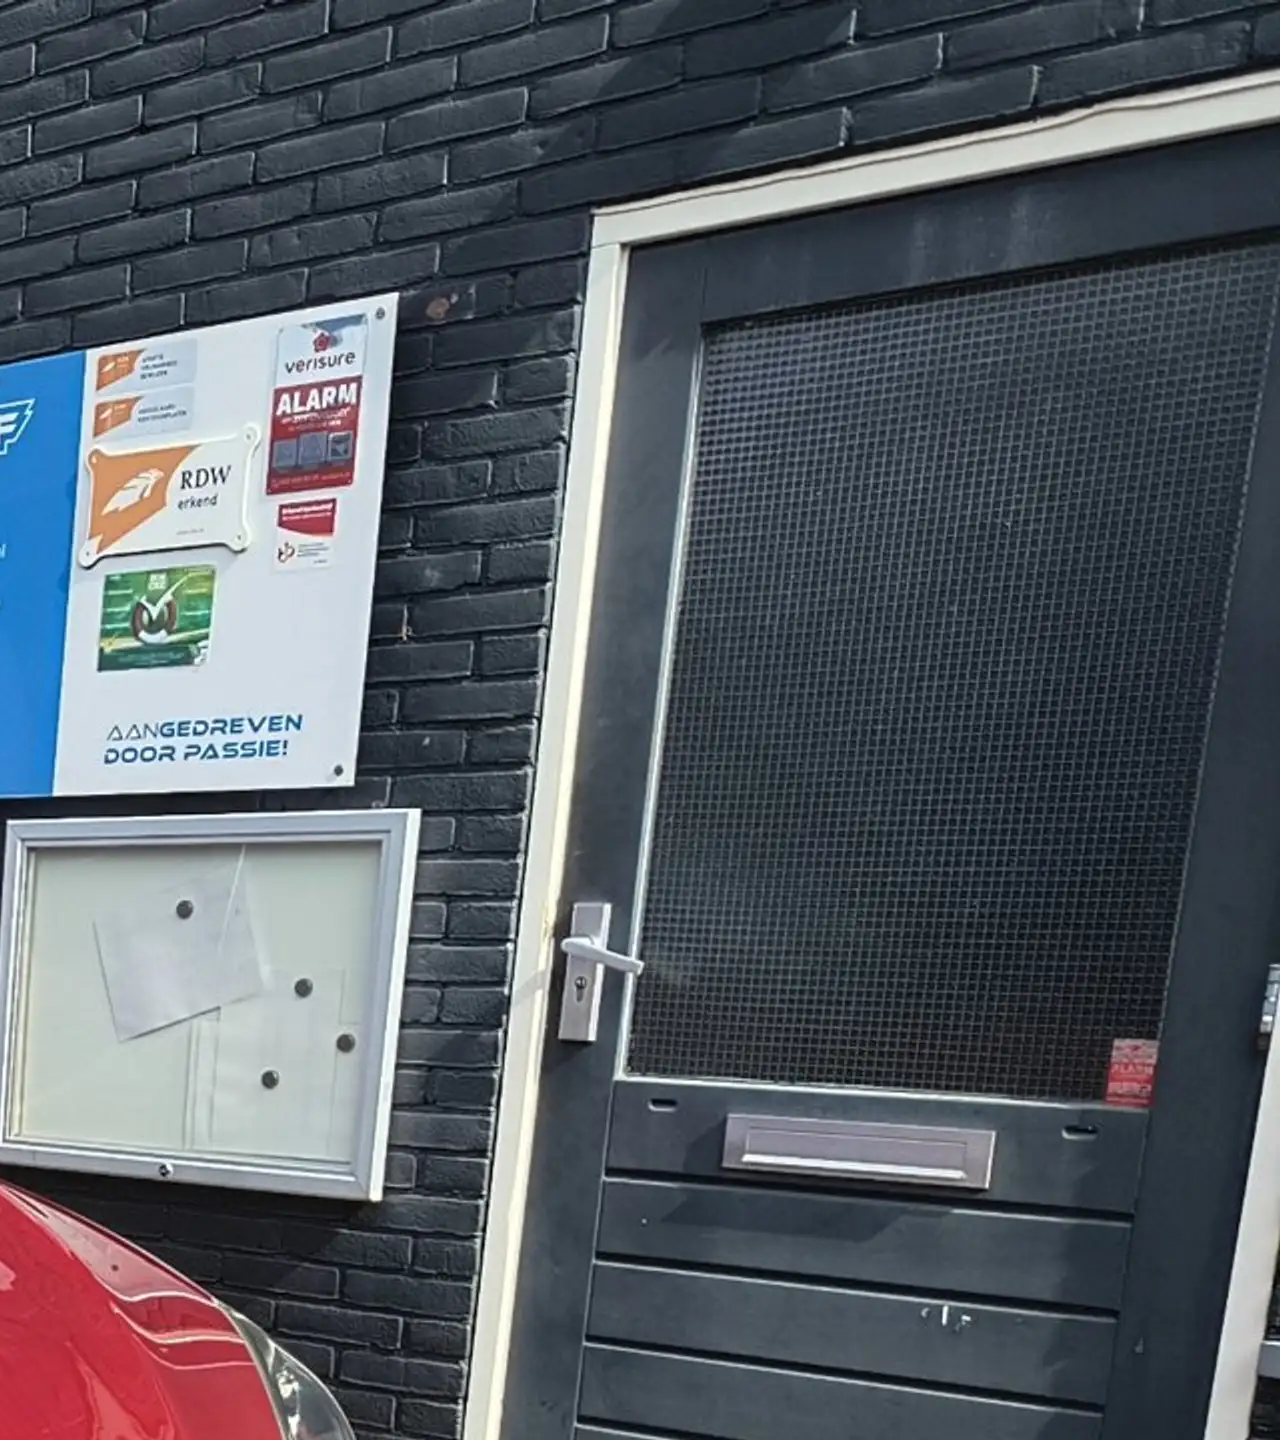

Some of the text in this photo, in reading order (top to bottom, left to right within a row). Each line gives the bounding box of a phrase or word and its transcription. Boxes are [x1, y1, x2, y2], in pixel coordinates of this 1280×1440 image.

[285, 351, 355, 374] verisure
[276, 382, 358, 416] ALARM
[180, 464, 232, 490] RDW
[178, 494, 219, 510] erkend
[106, 714, 303, 741] AANGEDREVEN
[104, 740, 289, 764] DOOR PASSIE!
